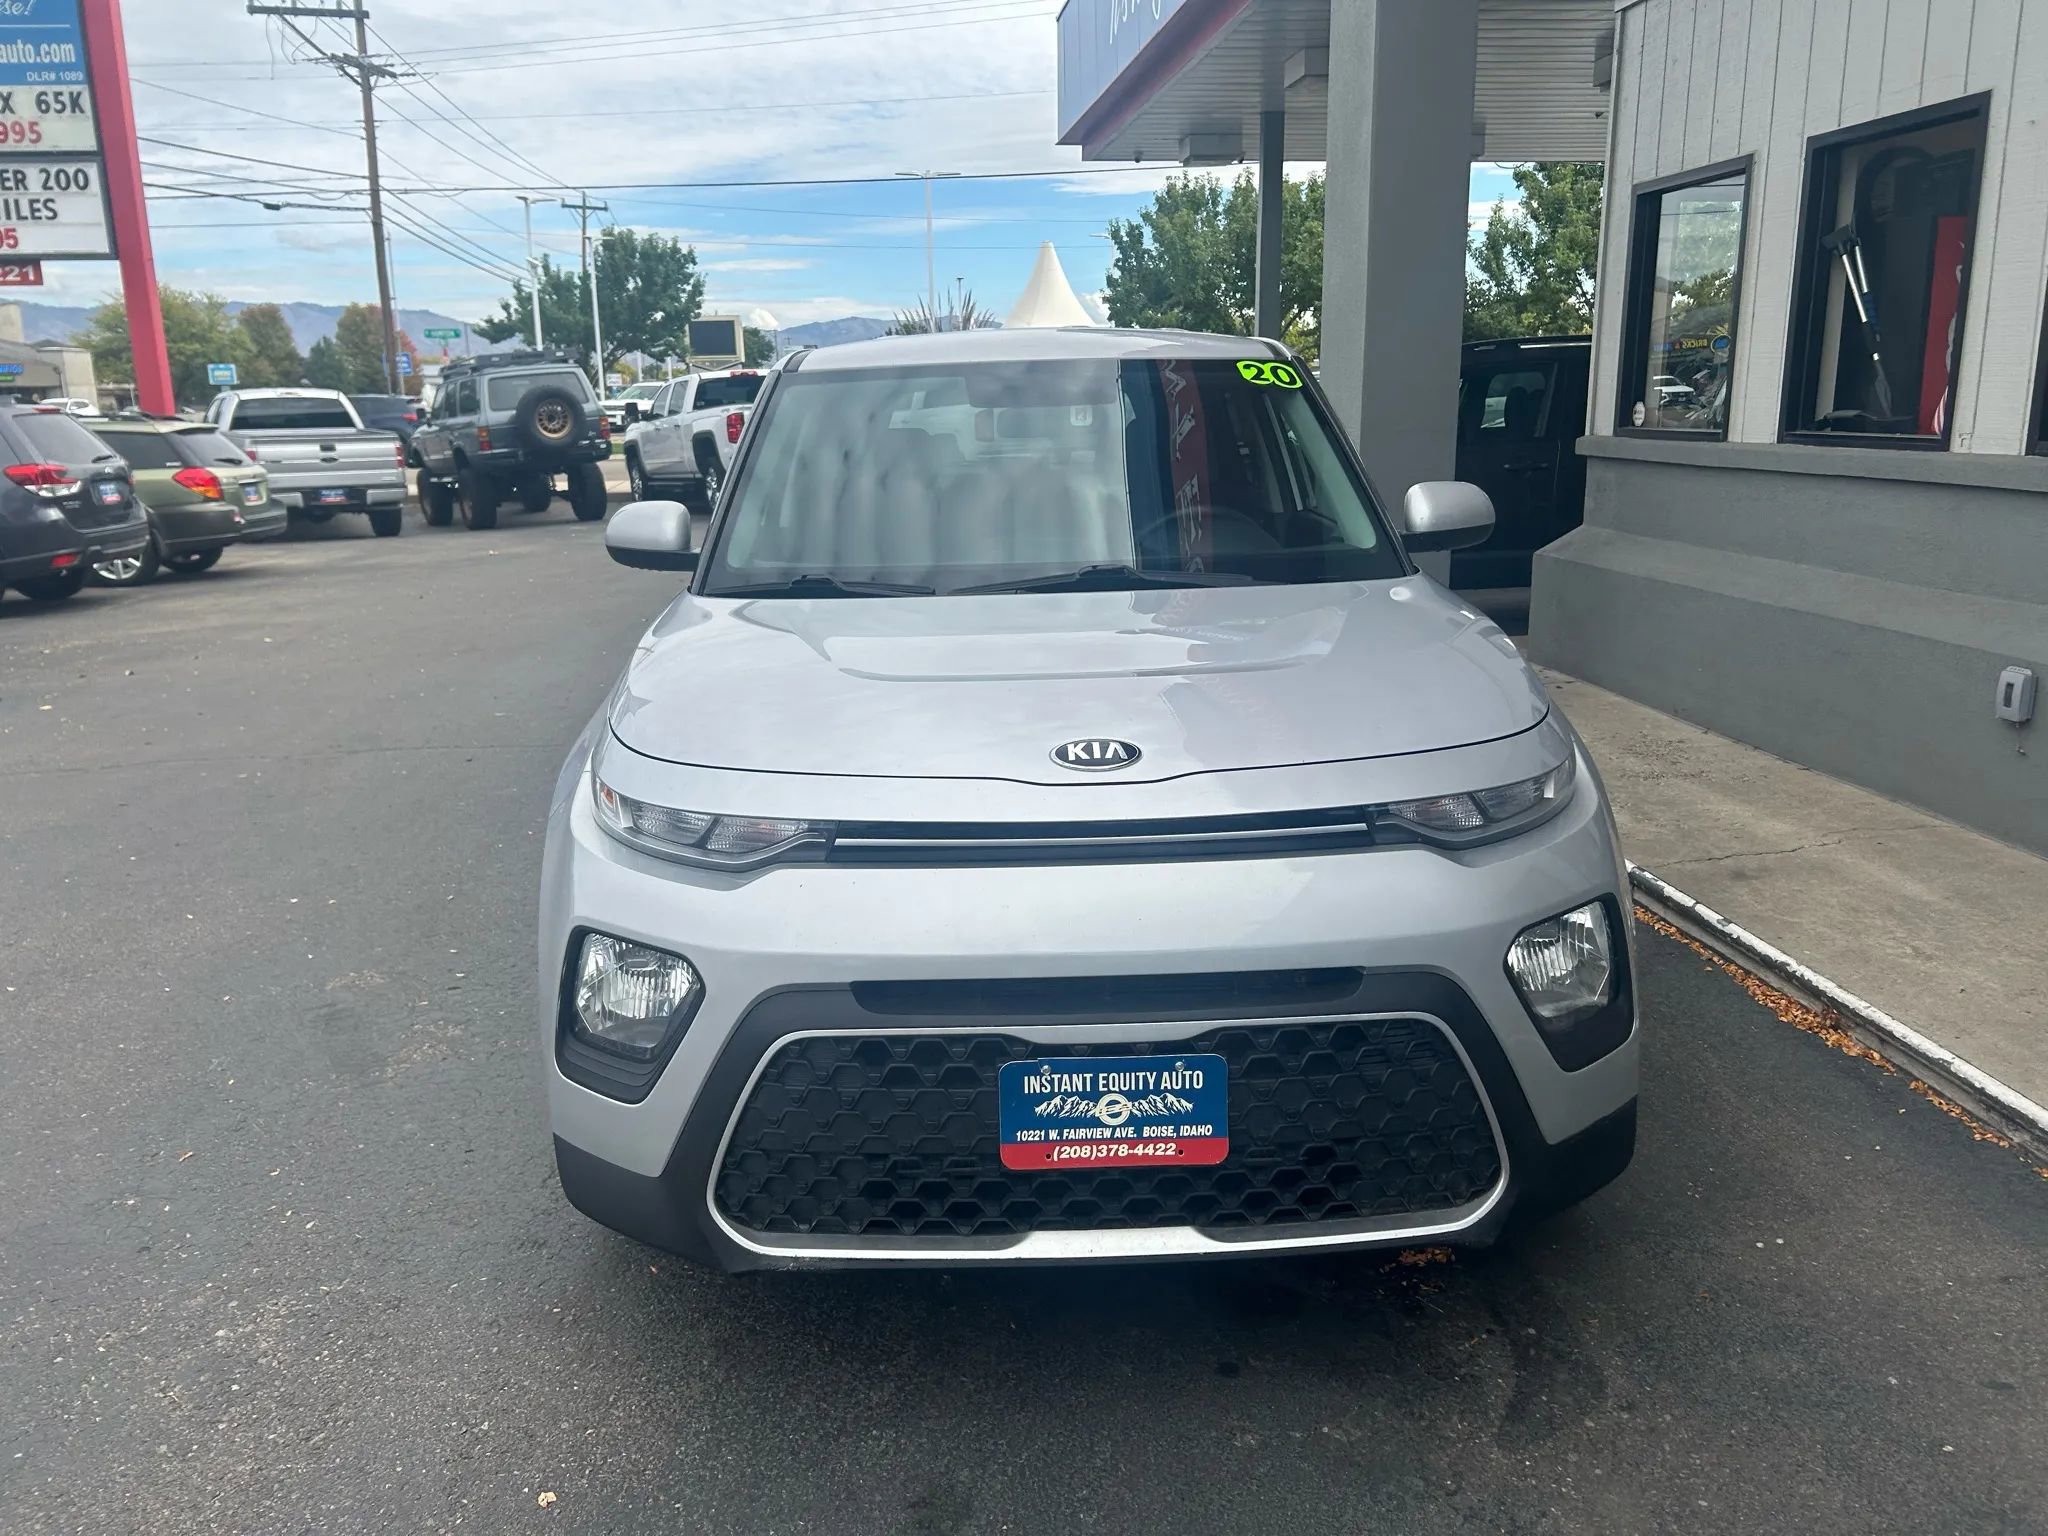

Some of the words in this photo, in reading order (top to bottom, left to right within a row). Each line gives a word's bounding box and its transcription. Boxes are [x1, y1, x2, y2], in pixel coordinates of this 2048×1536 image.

[35, 90, 86, 115] 65K
[38, 167, 90, 192] 200
[0, 198, 58, 221] ILES
[1242, 363, 1299, 386] 20
[1066, 741, 1129, 761] KIA
[1023, 1073, 1094, 1094] INSTANT
[1098, 1071, 1157, 1092] EQUITY
[1160, 1070, 1204, 1091] AUTO
[1016, 1130, 1046, 1142] 10221
[1048, 1128, 1061, 1141] W.
[1062, 1127, 1113, 1141] FAIRVIEW
[1113, 1126, 1138, 1139] AVE.
[1142, 1125, 1178, 1139] BOISE,
[1179, 1124, 1214, 1137] IDAHO
[1053, 1142, 1178, 1162] (208)378-4422
